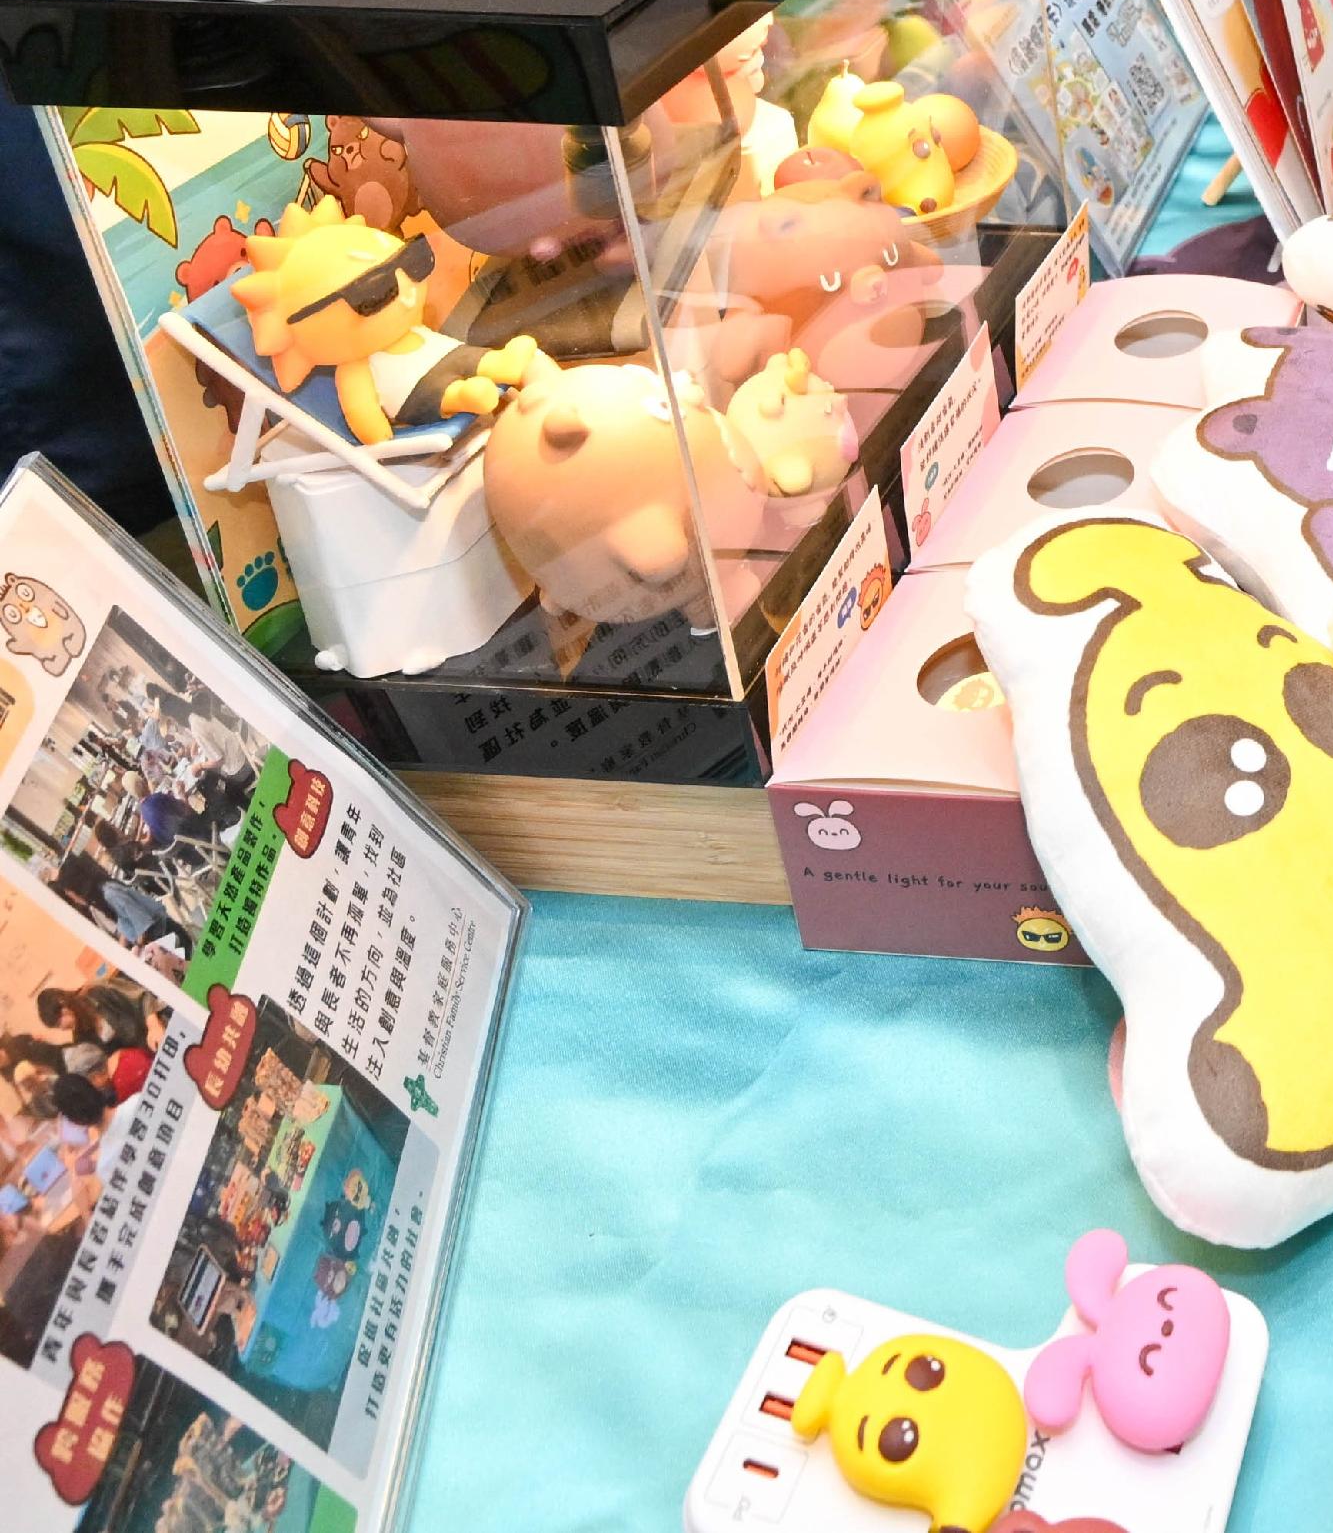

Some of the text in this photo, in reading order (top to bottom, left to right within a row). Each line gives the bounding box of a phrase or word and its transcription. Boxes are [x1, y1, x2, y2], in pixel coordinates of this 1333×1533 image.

[291, 777, 328, 851] 創意科技
[803, 867, 1050, 893] A gentle light for your sou
[285, 805, 363, 1013] 透過這個計劃，讓青年
[311, 826, 389, 1035] 與長者不再孤單，找到
[340, 849, 411, 1057] 生活的方向，並為社區
[415, 907, 465, 1065] 基督教家庭服務中心
[363, 915, 419, 1079] 注入創意與溫度。
[432, 921, 477, 1079] Christian Family Service Centre
[1010, 1428, 1050, 1511] omax
